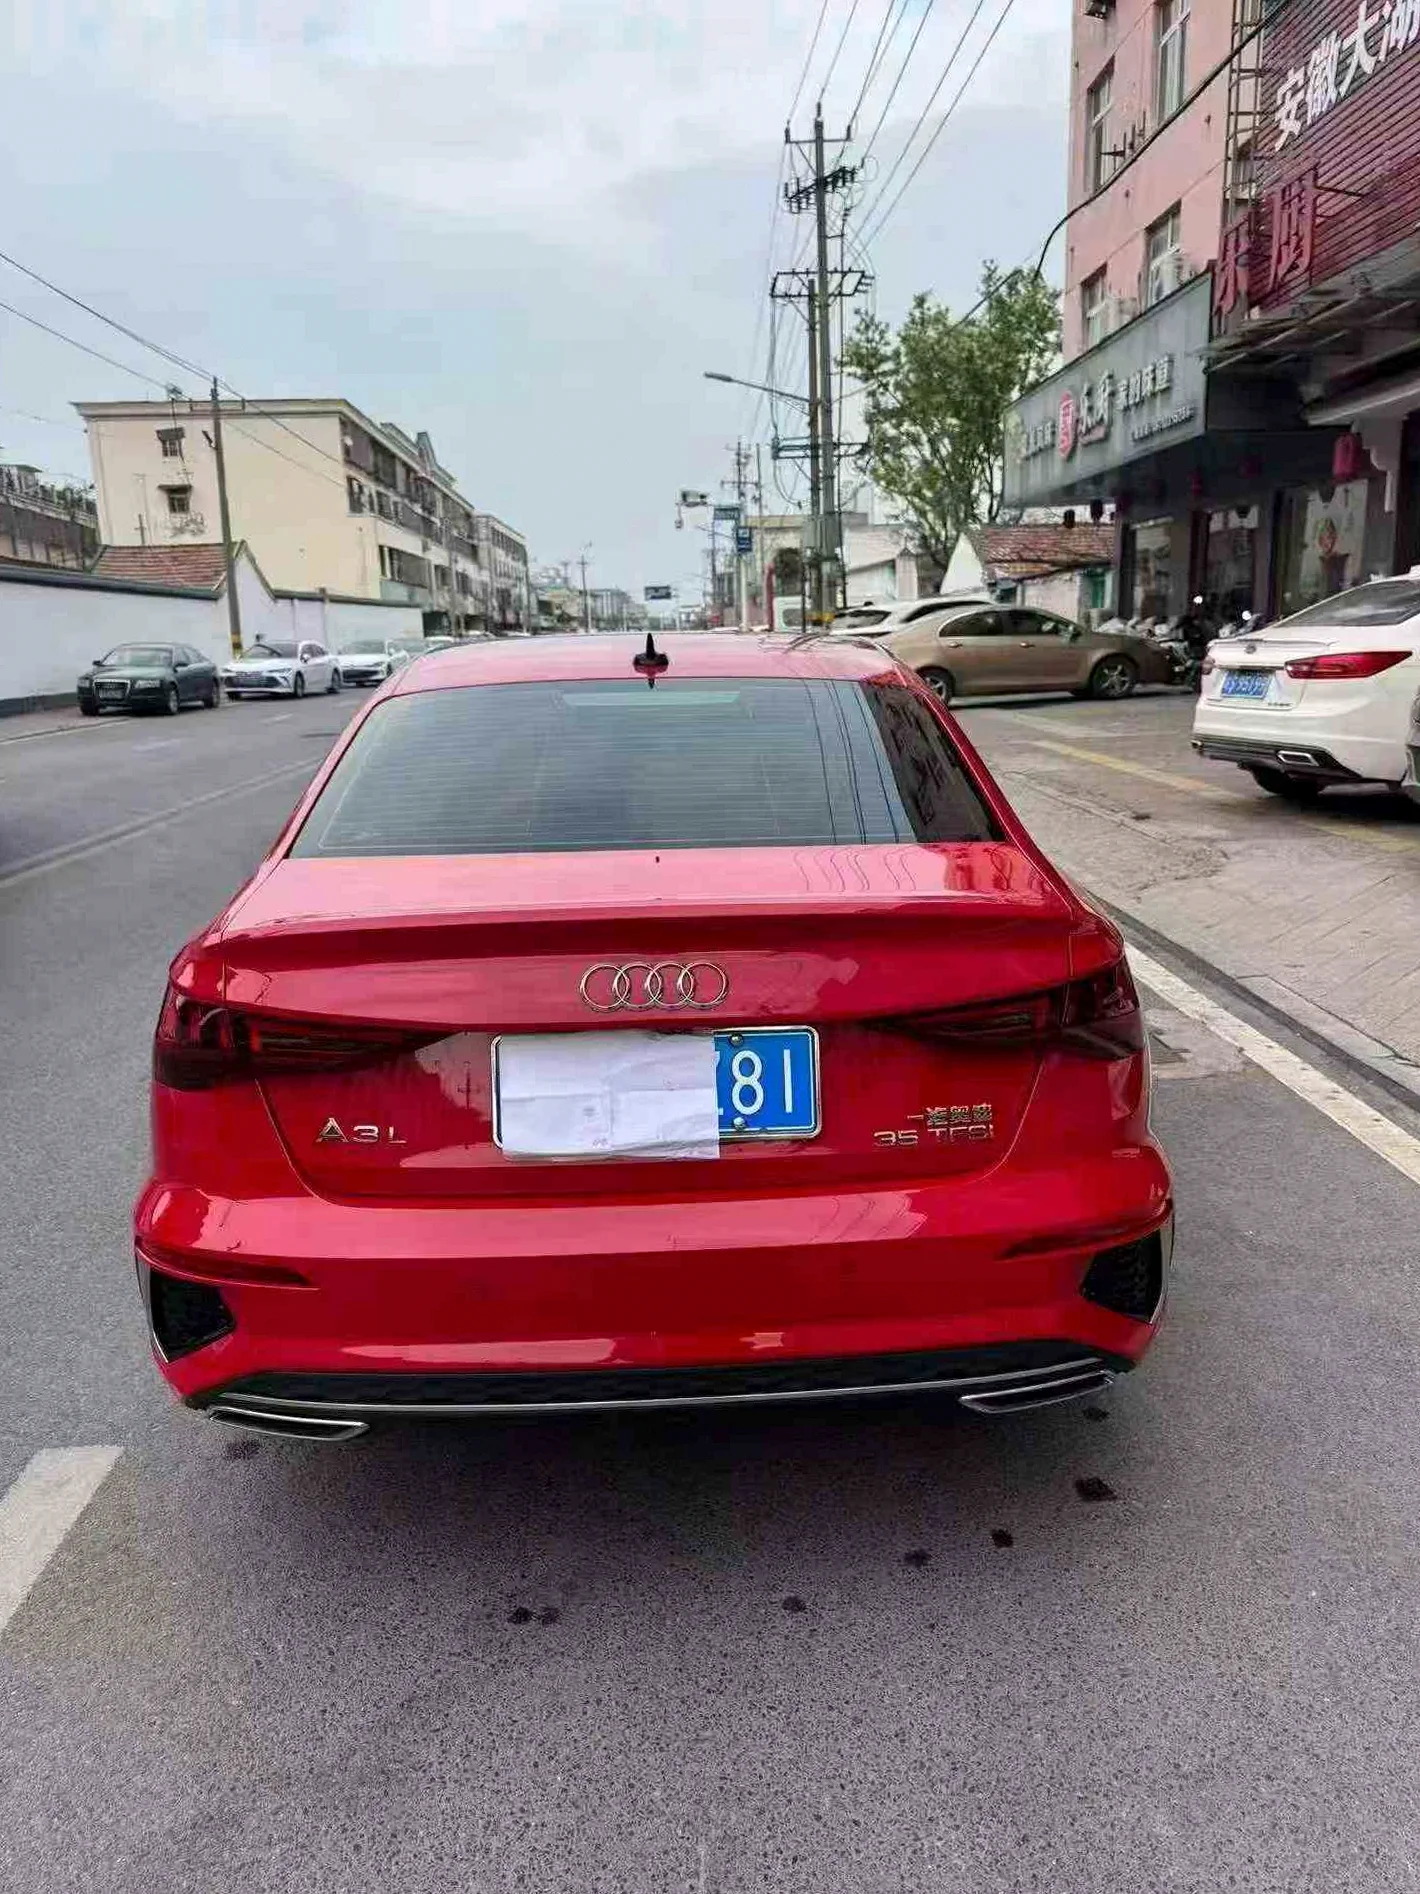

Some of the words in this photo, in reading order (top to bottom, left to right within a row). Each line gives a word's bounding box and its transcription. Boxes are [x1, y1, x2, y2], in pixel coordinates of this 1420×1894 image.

[715, 1049, 793, 1115] 81
[907, 1103, 992, 1125] 一汽奥迪
[873, 1130, 919, 1147] 35
